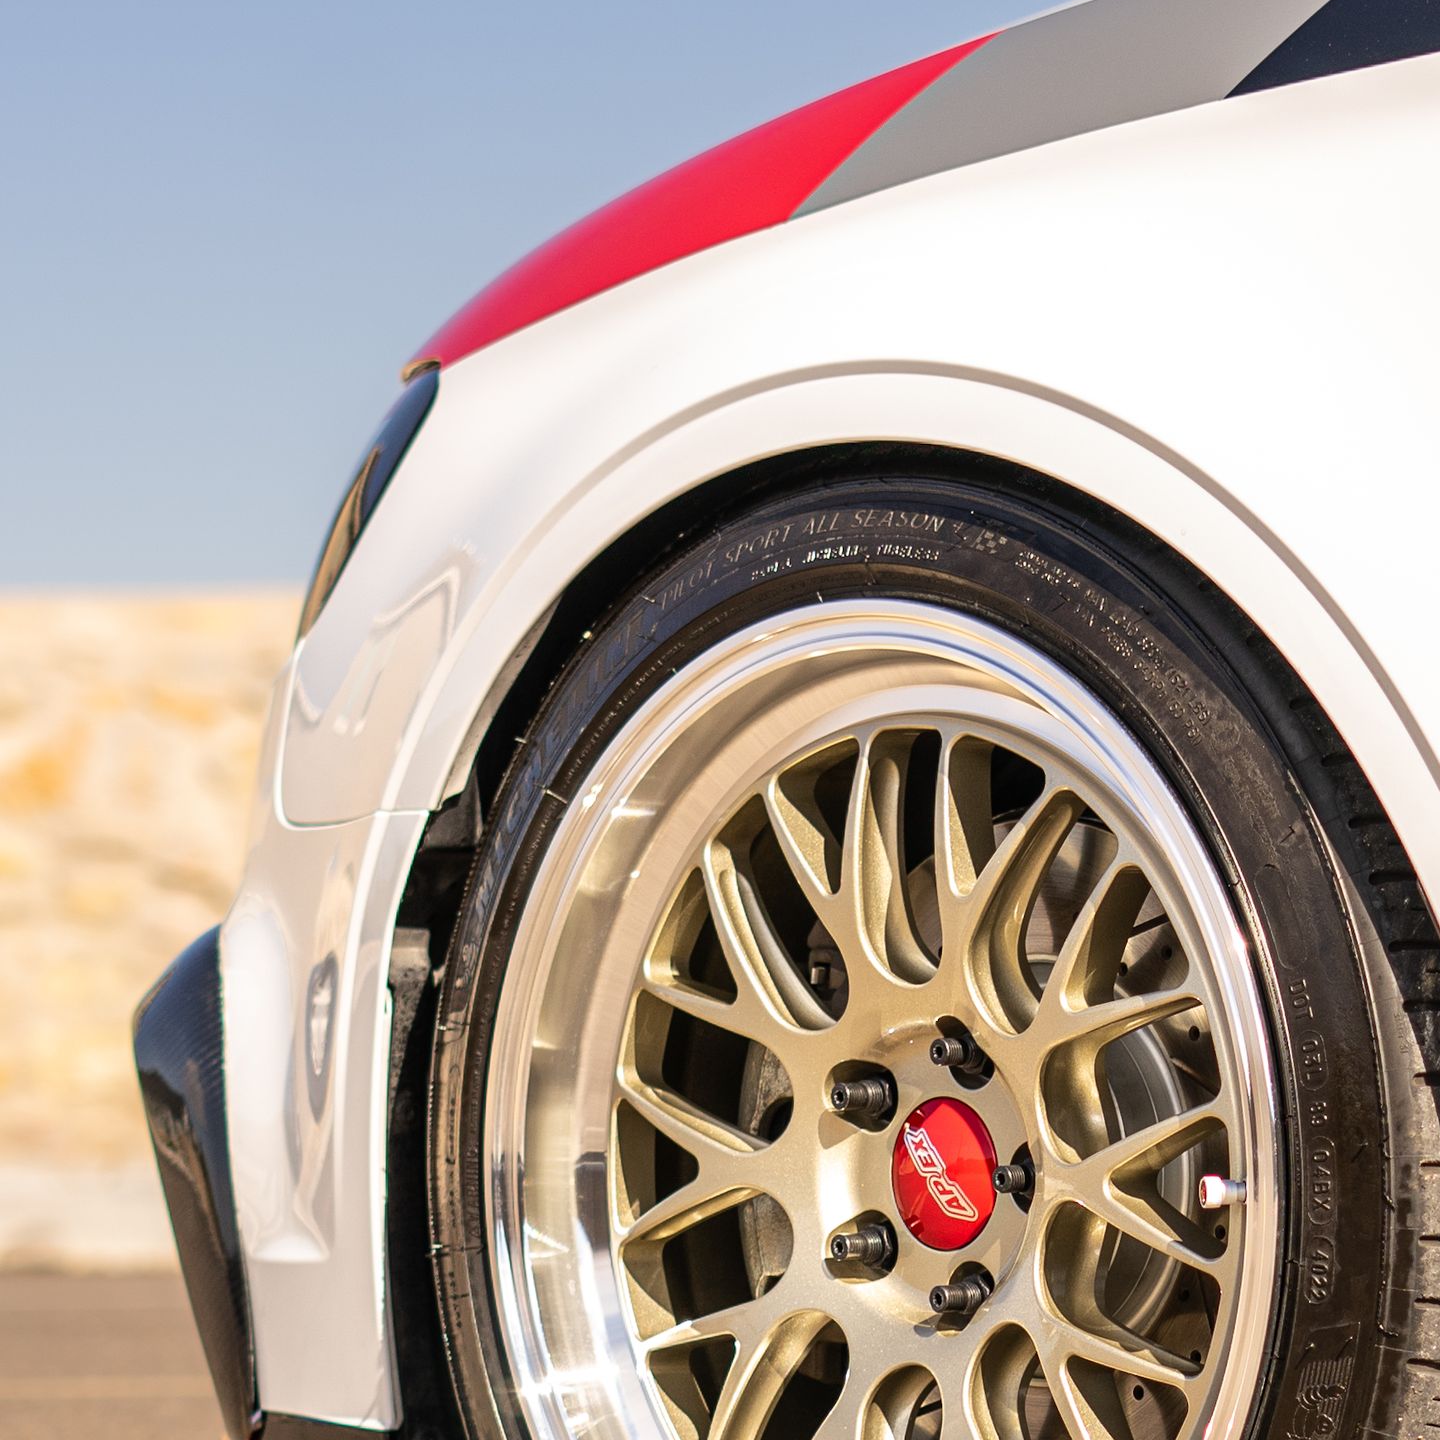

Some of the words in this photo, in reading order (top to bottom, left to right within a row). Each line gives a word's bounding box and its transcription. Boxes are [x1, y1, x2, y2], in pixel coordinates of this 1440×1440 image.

[661, 561, 716, 609] PILOT
[725, 522, 795, 562] SPORT
[802, 511, 840, 535] ALL
[850, 509, 945, 534] SEASON
[1289, 979, 1314, 1021] DOT
[1313, 1149, 1331, 1211] 04BX
[1311, 1249, 1329, 1299] 4022
